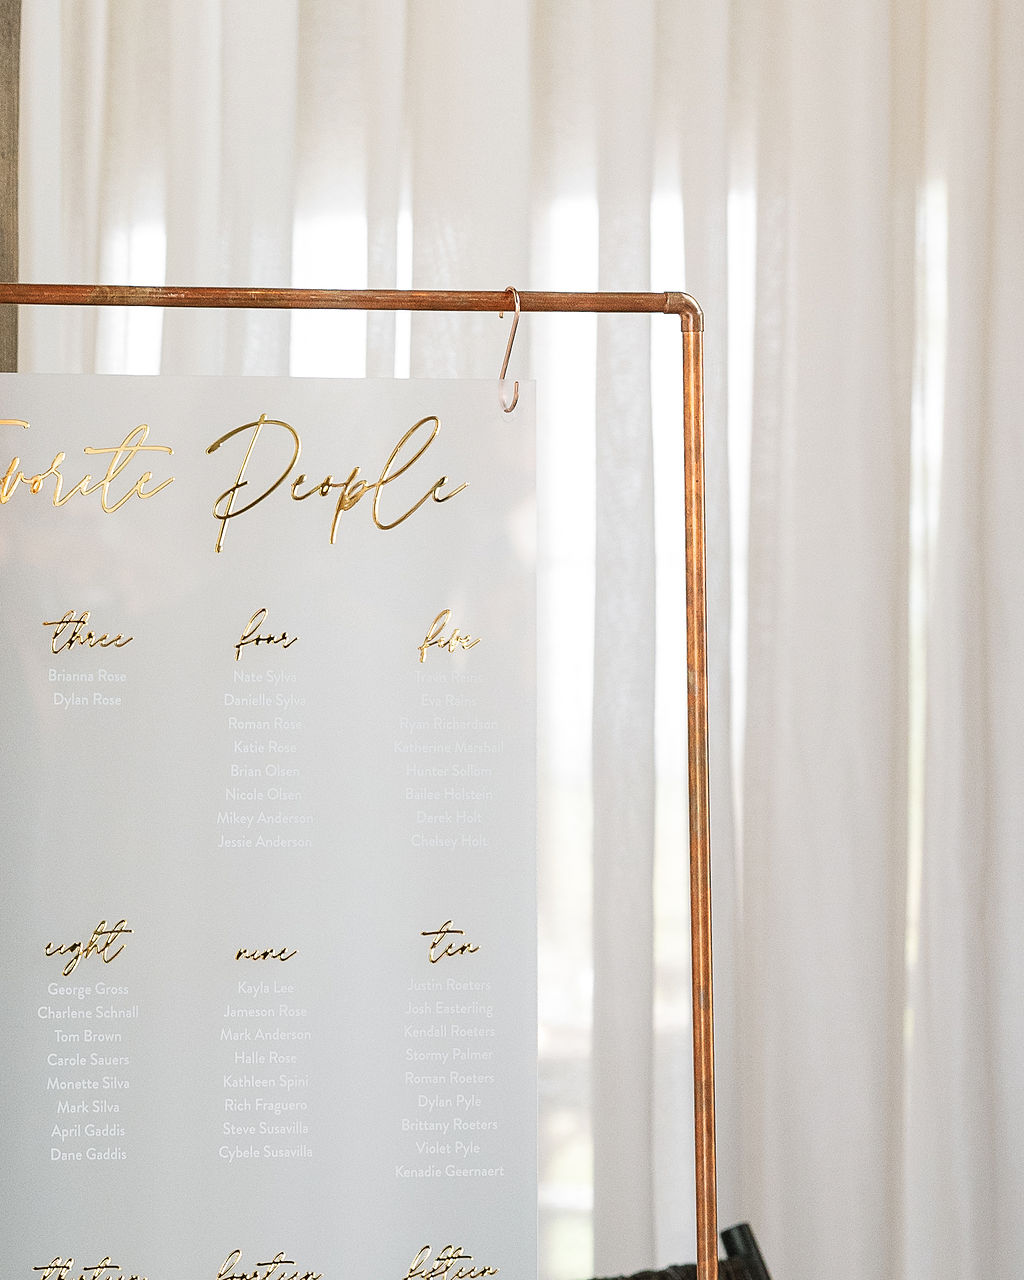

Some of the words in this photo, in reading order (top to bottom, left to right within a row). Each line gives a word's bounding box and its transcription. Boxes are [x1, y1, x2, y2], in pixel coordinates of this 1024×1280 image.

[206, 413, 471, 553] People
[42, 609, 134, 655] three
[234, 607, 299, 661] four
[417, 608, 482, 663] five
[48, 668, 94, 682] Brianna
[97, 668, 127, 682] Rose
[53, 692, 89, 711] Dylan
[92, 692, 122, 706] Rose
[44, 919, 134, 976] eight
[421, 919, 481, 964] ten
[234, 943, 298, 962] nine
[47, 982, 92, 1000] George
[94, 981, 129, 995] Gross
[37, 1005, 93, 1020] Charlene
[95, 1005, 139, 1019] Schnall
[53, 1029, 80, 1043] Tom
[83, 1029, 122, 1043] Brown
[46, 1076, 100, 1090] Monette
[102, 1075, 130, 1090] Silva
[223, 1074, 276, 1088] Kathleen
[279, 1074, 309, 1092] Spini
[224, 1098, 252, 1112] Rich
[255, 1097, 308, 1116] Fraguero
[50, 1124, 81, 1142] April
[84, 1123, 126, 1137] Gaddis
[222, 1121, 256, 1136] Steve
[258, 1121, 309, 1135] Susavilla
